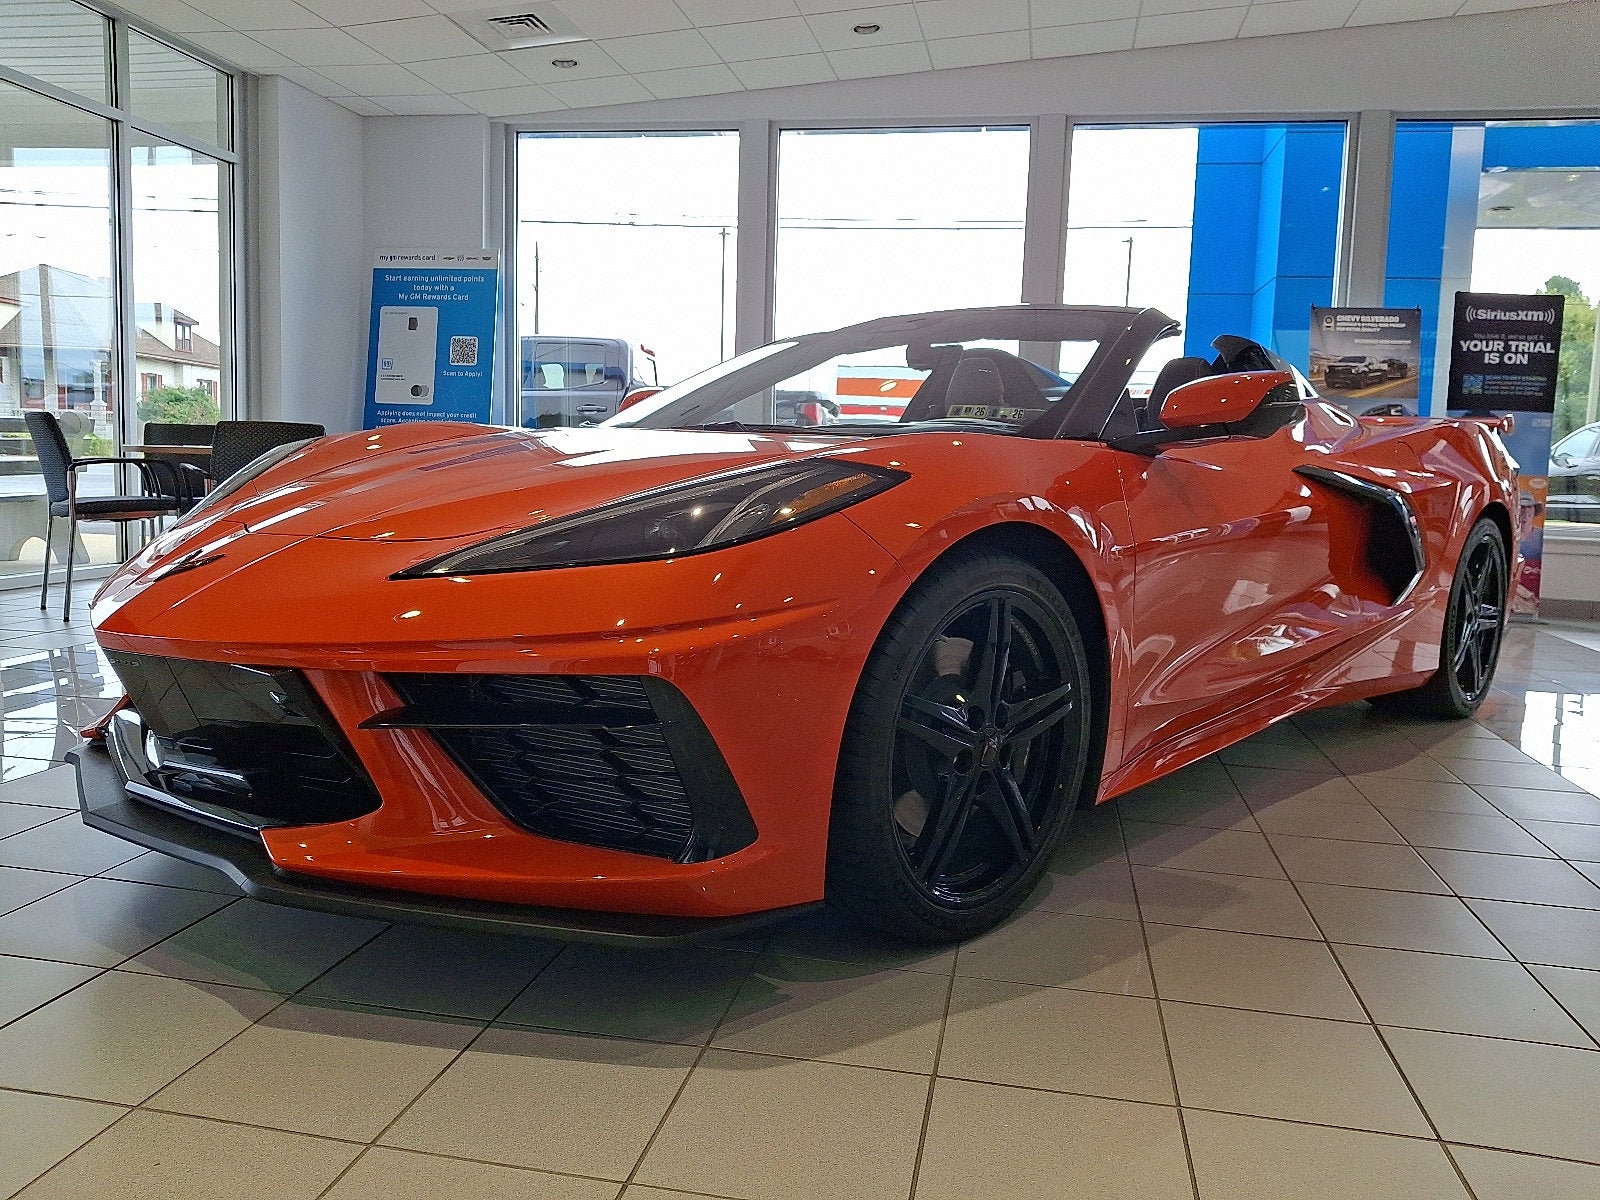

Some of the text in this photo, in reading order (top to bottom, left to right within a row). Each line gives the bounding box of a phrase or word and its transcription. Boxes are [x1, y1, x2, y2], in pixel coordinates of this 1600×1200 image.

[385, 274, 402, 282] Start
[414, 284, 433, 292] today
[398, 293, 408, 301] My
[1361, 315, 1400, 323] SILVERADO
[1460, 340, 1555, 354] YOUR TRIAL
[1484, 353, 1528, 364] IS ON
[974, 406, 986, 416] 26
[1012, 409, 1024, 418] 26
